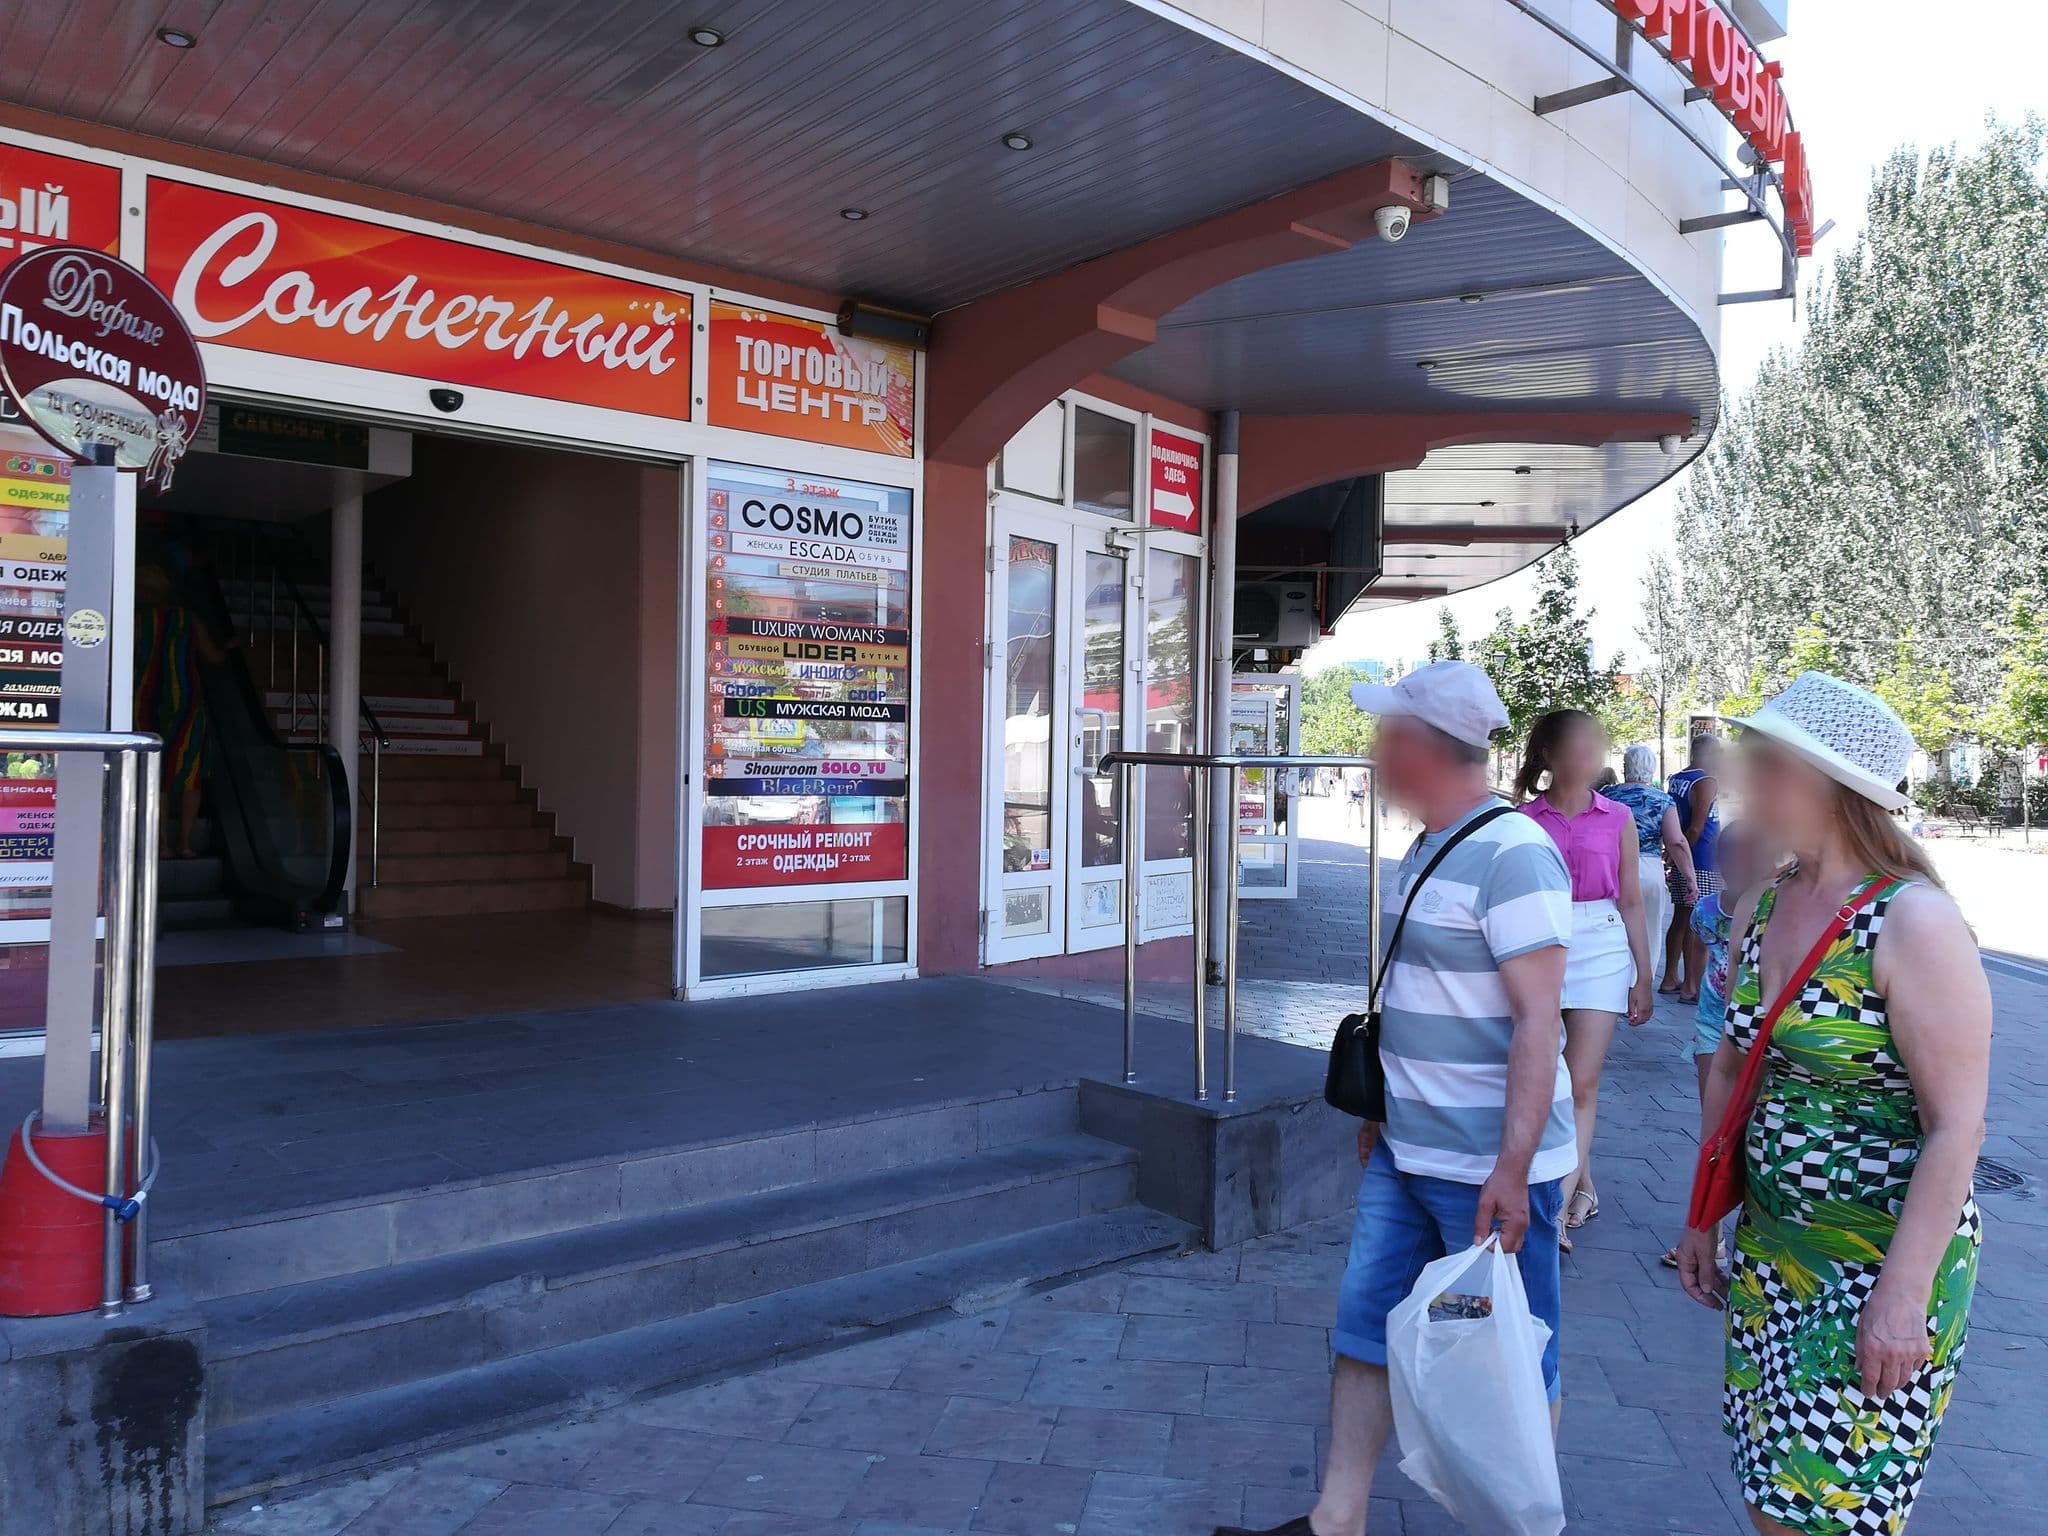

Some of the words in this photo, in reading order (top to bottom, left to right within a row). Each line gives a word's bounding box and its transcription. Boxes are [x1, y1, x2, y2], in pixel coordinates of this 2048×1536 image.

[1616, 0, 1788, 162] ГОВЫЙ
[43, 255, 164, 347] Дефиле
[172, 212, 678, 376] Солнечный
[1, 303, 131, 386] Польская
[138, 367, 199, 412] мода
[735, 335, 888, 398] ТОРГОВЫЙ
[736, 376, 888, 426] ЦЕНТР
[1152, 445, 1199, 470] ПОДКЛЮЧИСЬ
[1164, 467, 1186, 484] ЗДЕСЬ
[786, 478, 796, 492] 3
[801, 483, 841, 499] этаж
[715, 516, 724, 526] 2
[742, 500, 863, 540] COSMO
[868, 515, 897, 526] БУТИК
[715, 537, 723, 546] 3
[868, 530, 897, 538] ОДЕЖДЫ
[746, 540, 783, 552] ЖЕНСКАЯ
[789, 541, 856, 563] ESCADA
[858, 552, 893, 564] ОБУВЬ
[715, 558, 723, 567] 4
[13, 567, 67, 582] ОДЕЖ
[792, 565, 830, 578] СТУДИЯ
[836, 570, 878, 582] ПЛАТЬЕВ
[715, 579, 723, 589] 5
[31, 598, 66, 609] бель
[715, 599, 723, 609] 6
[752, 620, 805, 638] LUXURY
[810, 623, 886, 644] WOMAN'S
[715, 642, 722, 651] 8
[738, 643, 780, 654] ОБУВНОЙ
[783, 642, 857, 662] LIDER
[861, 652, 899, 662] БУТИК
[715, 662, 722, 671] 9
[800, 665, 859, 682] ИНДИГО
[725, 683, 776, 697] СПОРТ
[776, 703, 846, 718] МУЖСКАЯ
[851, 707, 891, 719] МОДА
[744, 763, 817, 776] Showroom
[760, 779, 864, 794] BlackBerry
[738, 830, 811, 850] СРОЧНЫЙ
[815, 832, 872, 848] РЕМОНТ
[737, 857, 743, 866] 2
[745, 857, 768, 866] этаж
[773, 853, 838, 872] ОДЕЖДЫ
[842, 854, 848, 862] 2
[849, 854, 871, 862] этаж
